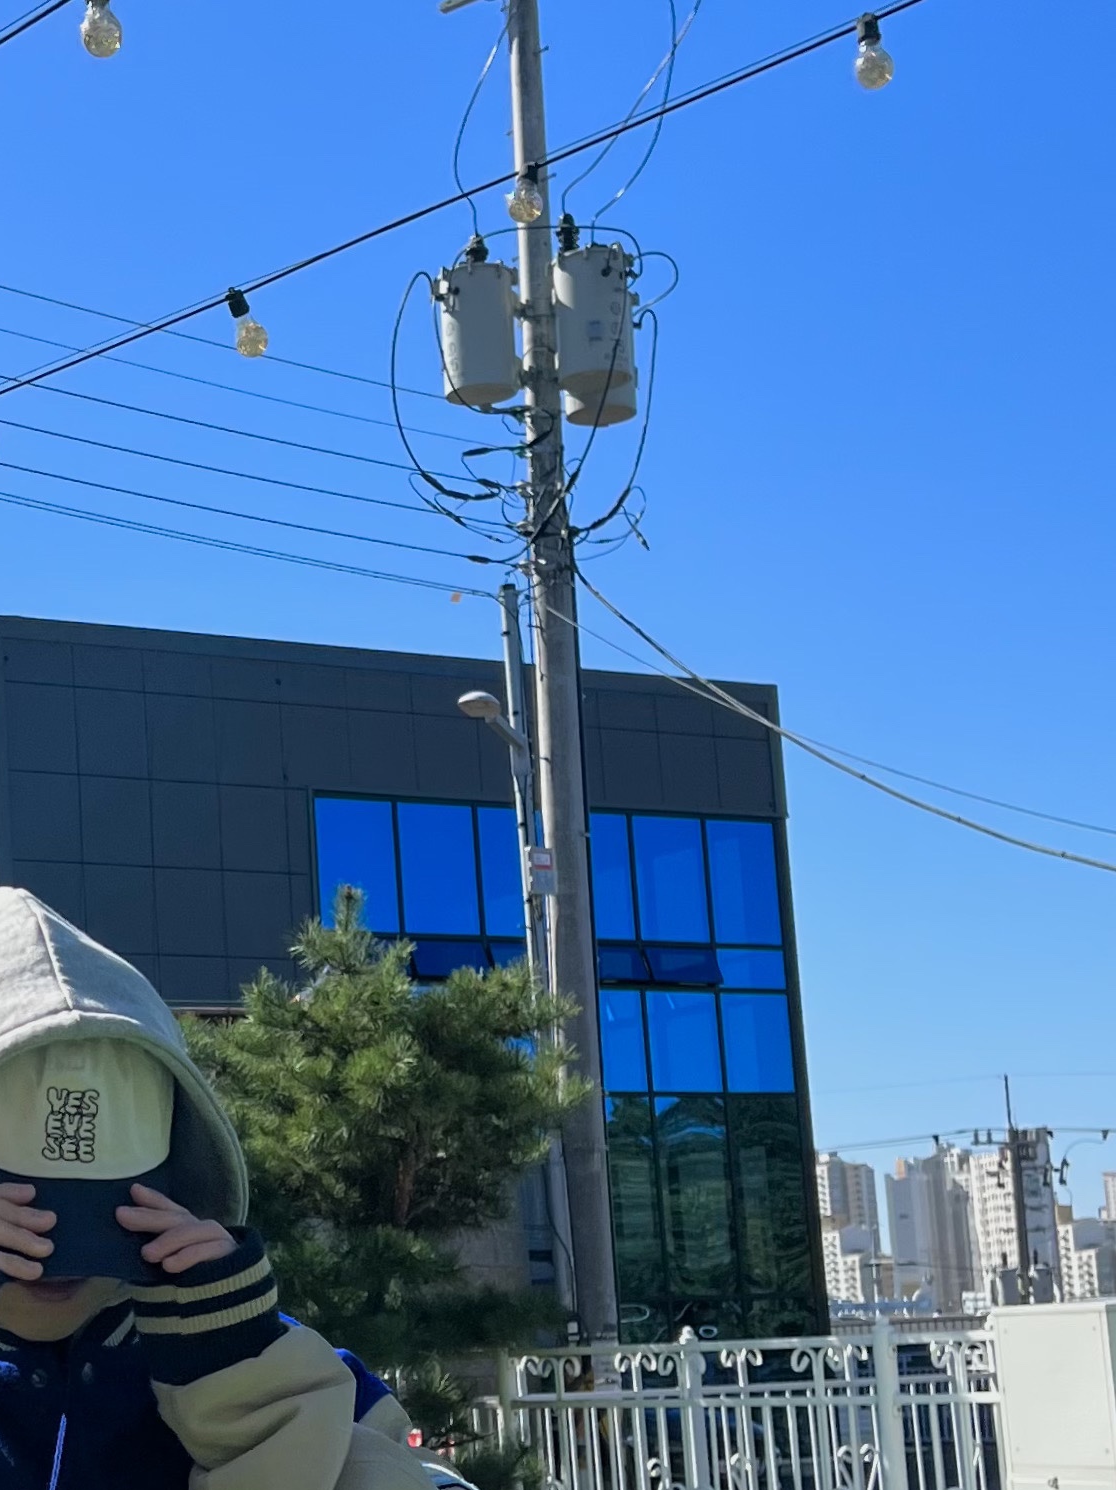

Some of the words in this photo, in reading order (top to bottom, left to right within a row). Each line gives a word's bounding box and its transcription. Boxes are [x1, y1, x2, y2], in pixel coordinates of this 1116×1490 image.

[46, 1086, 100, 1115] YES
[45, 1111, 96, 1139] EYE
[42, 1136, 96, 1163] SEE
